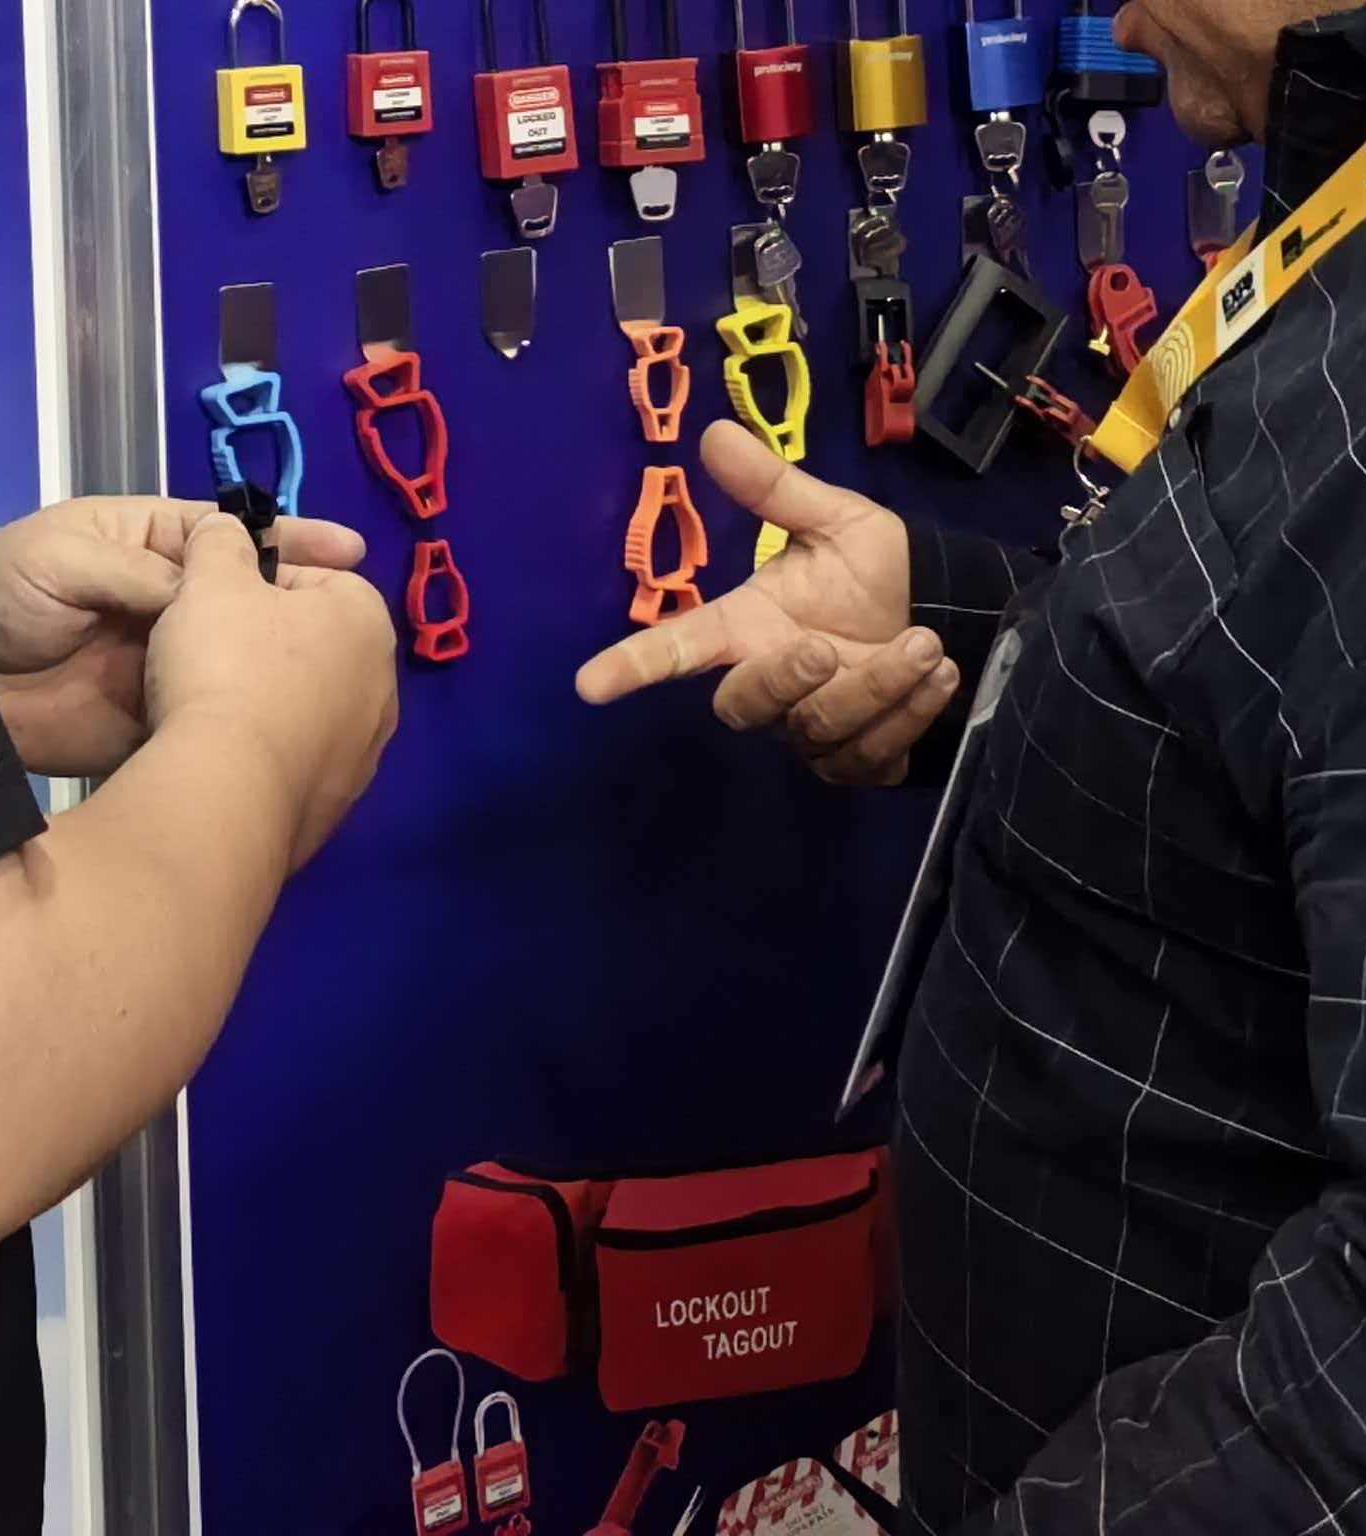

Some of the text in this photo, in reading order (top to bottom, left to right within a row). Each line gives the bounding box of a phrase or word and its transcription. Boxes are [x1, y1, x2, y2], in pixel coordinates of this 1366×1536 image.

[517, 112, 556, 124] LOCKED
[527, 127, 548, 137] OUT
[655, 1286, 772, 1328] LOCKOUT
[703, 1321, 798, 1360] TAGOUT
